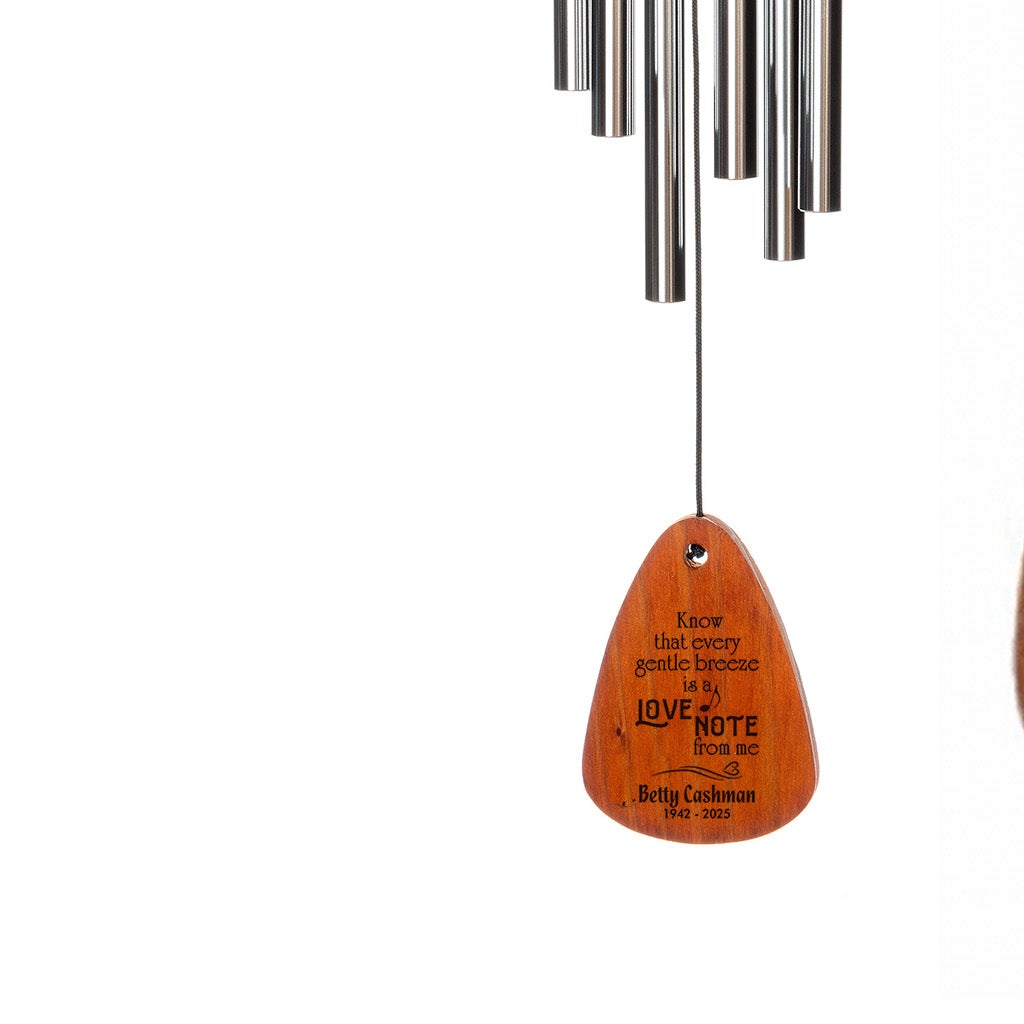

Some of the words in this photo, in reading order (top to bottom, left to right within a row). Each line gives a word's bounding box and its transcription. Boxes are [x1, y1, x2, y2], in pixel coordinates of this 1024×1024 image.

[677, 612, 723, 628] Know
[654, 632, 688, 650] that
[691, 637, 741, 655] every
[634, 653, 691, 678] gentle
[695, 653, 760, 671] breeze
[683, 675, 698, 693] is
[702, 680, 711, 693] a
[635, 698, 692, 728] LOVE
[694, 714, 758, 737] NOTE
[693, 737, 731, 756] from
[735, 743, 760, 756] me
[638, 784, 679, 808] Betty
[683, 784, 756, 804] Cashman
[663, 808, 691, 820] 1942
[702, 808, 731, 820] 2025
